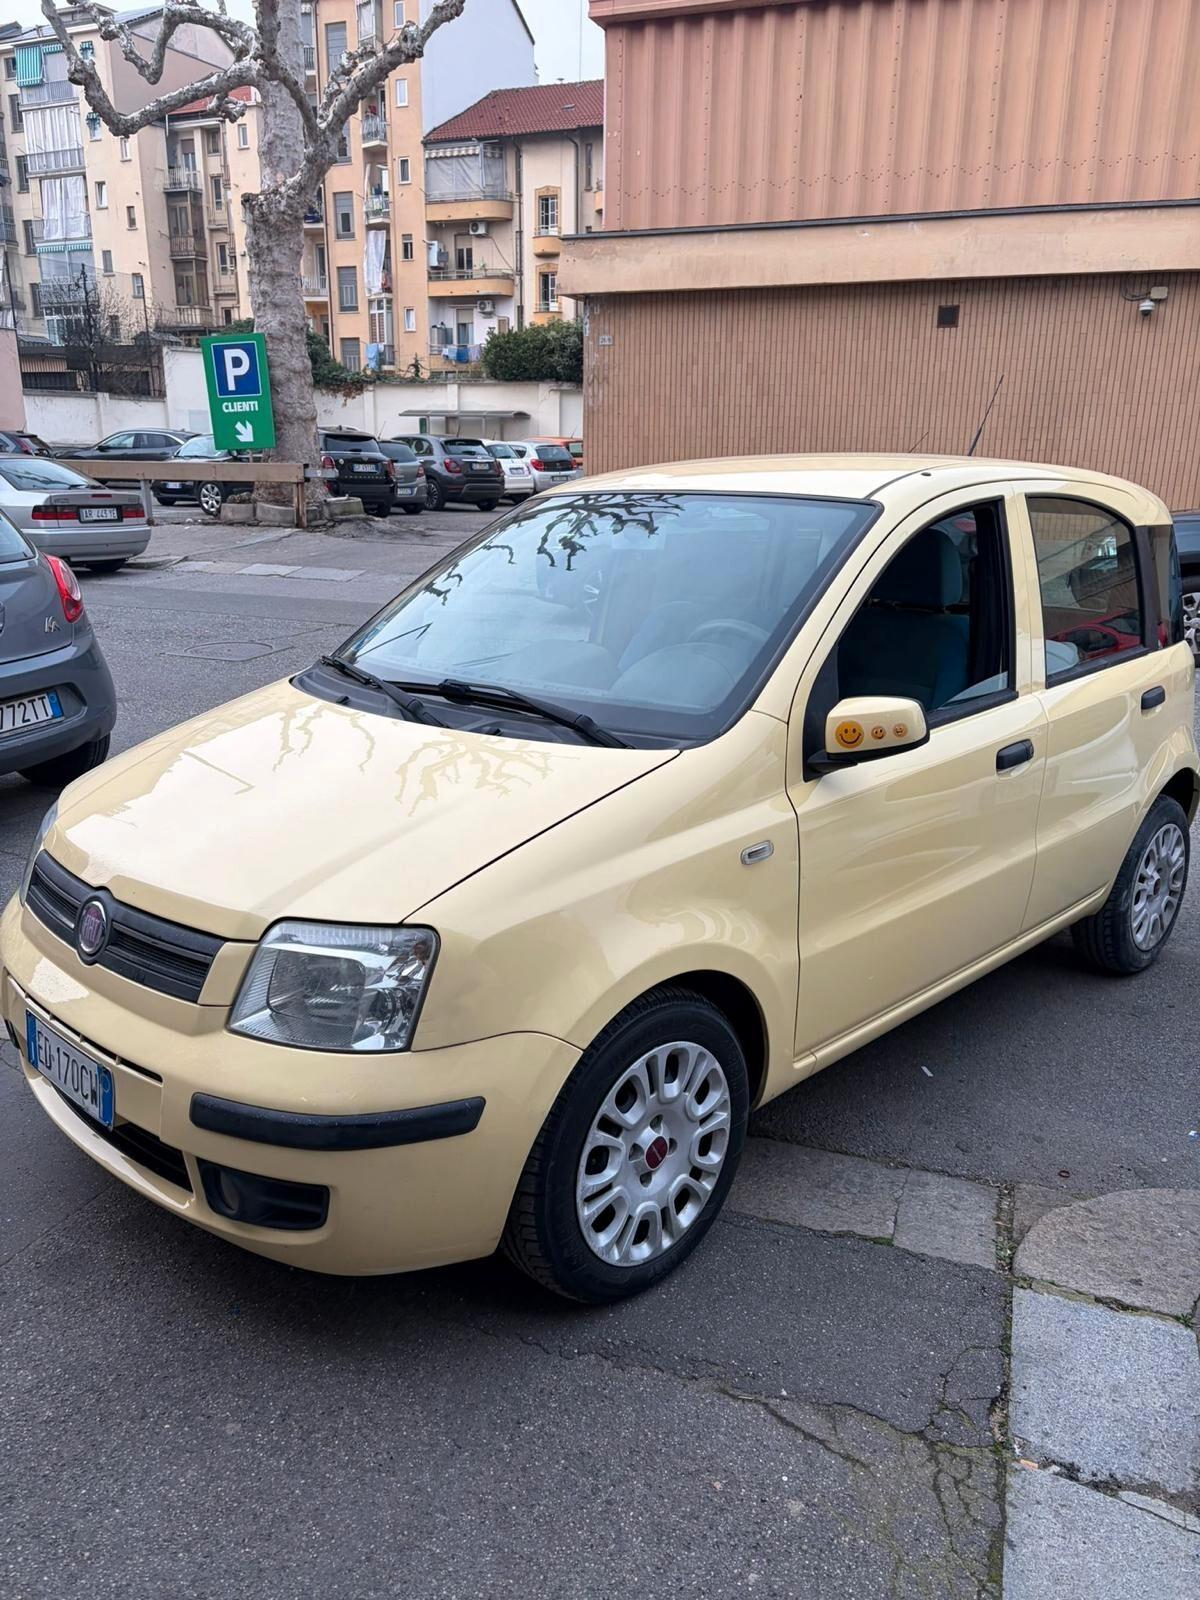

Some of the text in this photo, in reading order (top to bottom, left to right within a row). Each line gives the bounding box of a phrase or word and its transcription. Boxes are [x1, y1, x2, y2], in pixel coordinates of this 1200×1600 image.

[223, 348, 250, 391] P
[222, 400, 259, 413] CLIENTI
[81, 913, 101, 942] FIAT
